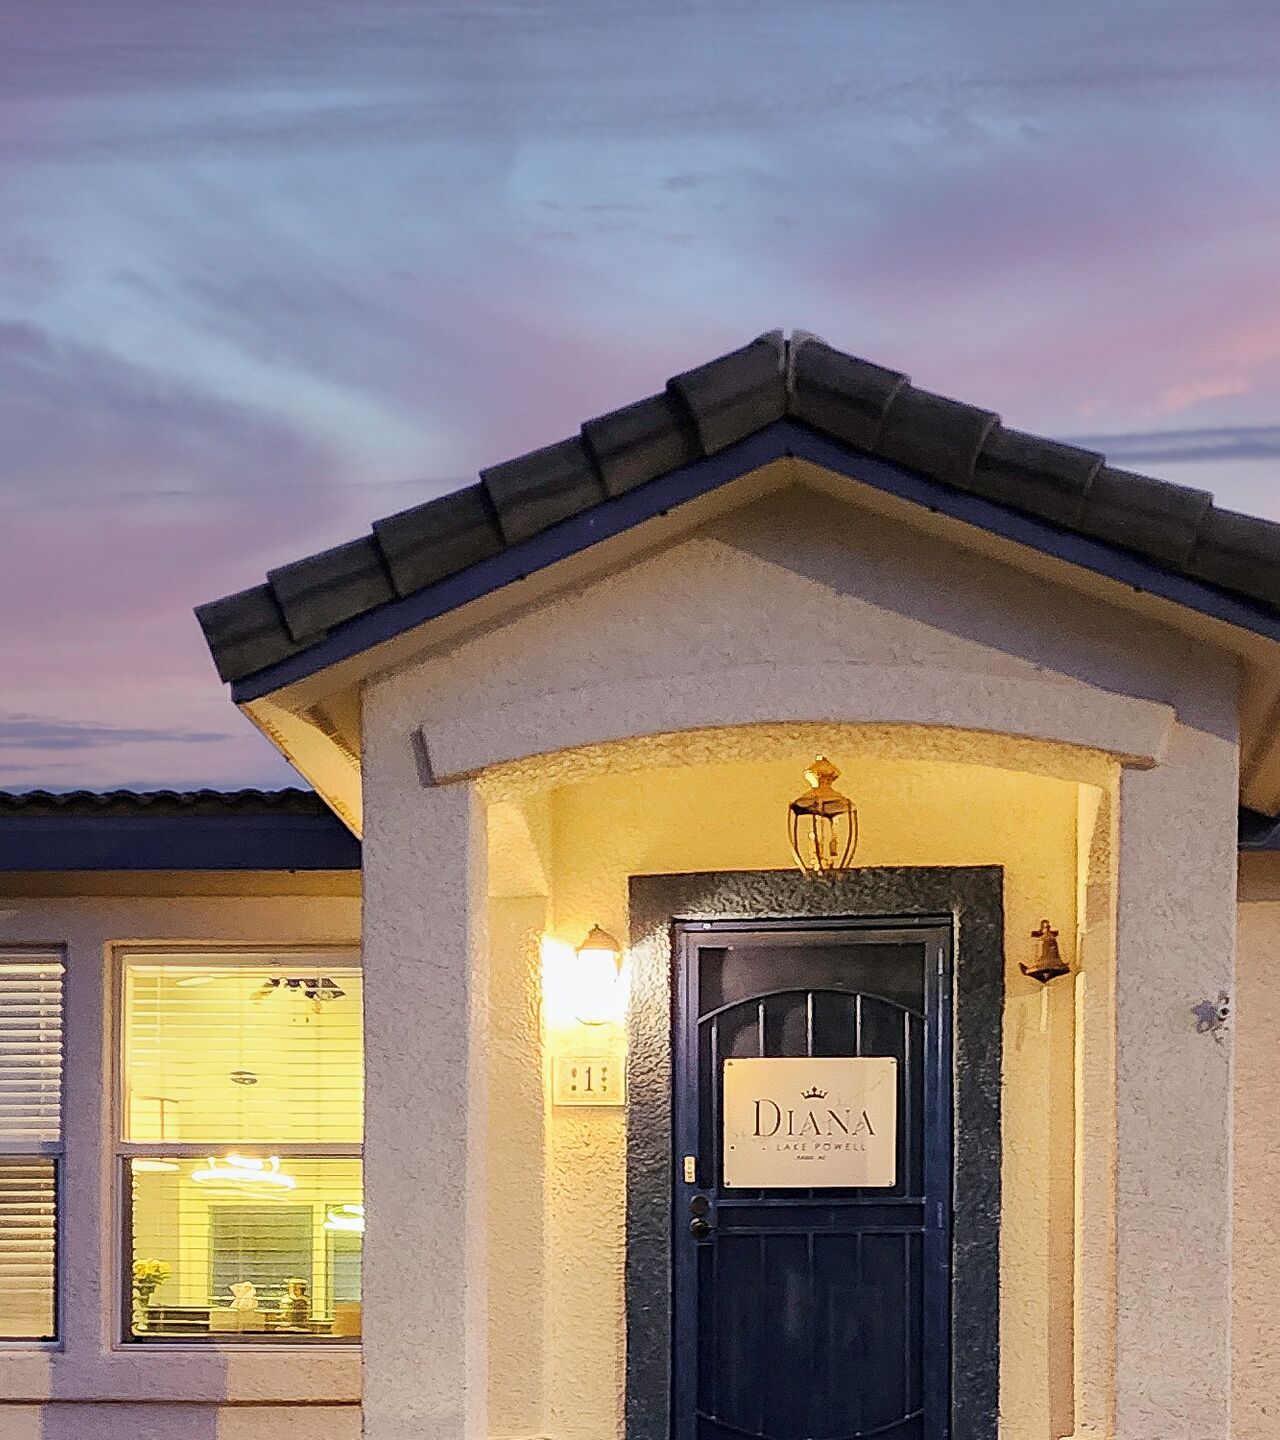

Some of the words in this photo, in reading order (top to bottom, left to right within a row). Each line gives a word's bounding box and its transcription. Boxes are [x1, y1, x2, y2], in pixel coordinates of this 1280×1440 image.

[584, 1066, 594, 1092] 1
[752, 1099, 876, 1137] DIANA
[776, 1142, 807, 1152] LAKE
[814, 1142, 867, 1152] POWELL
